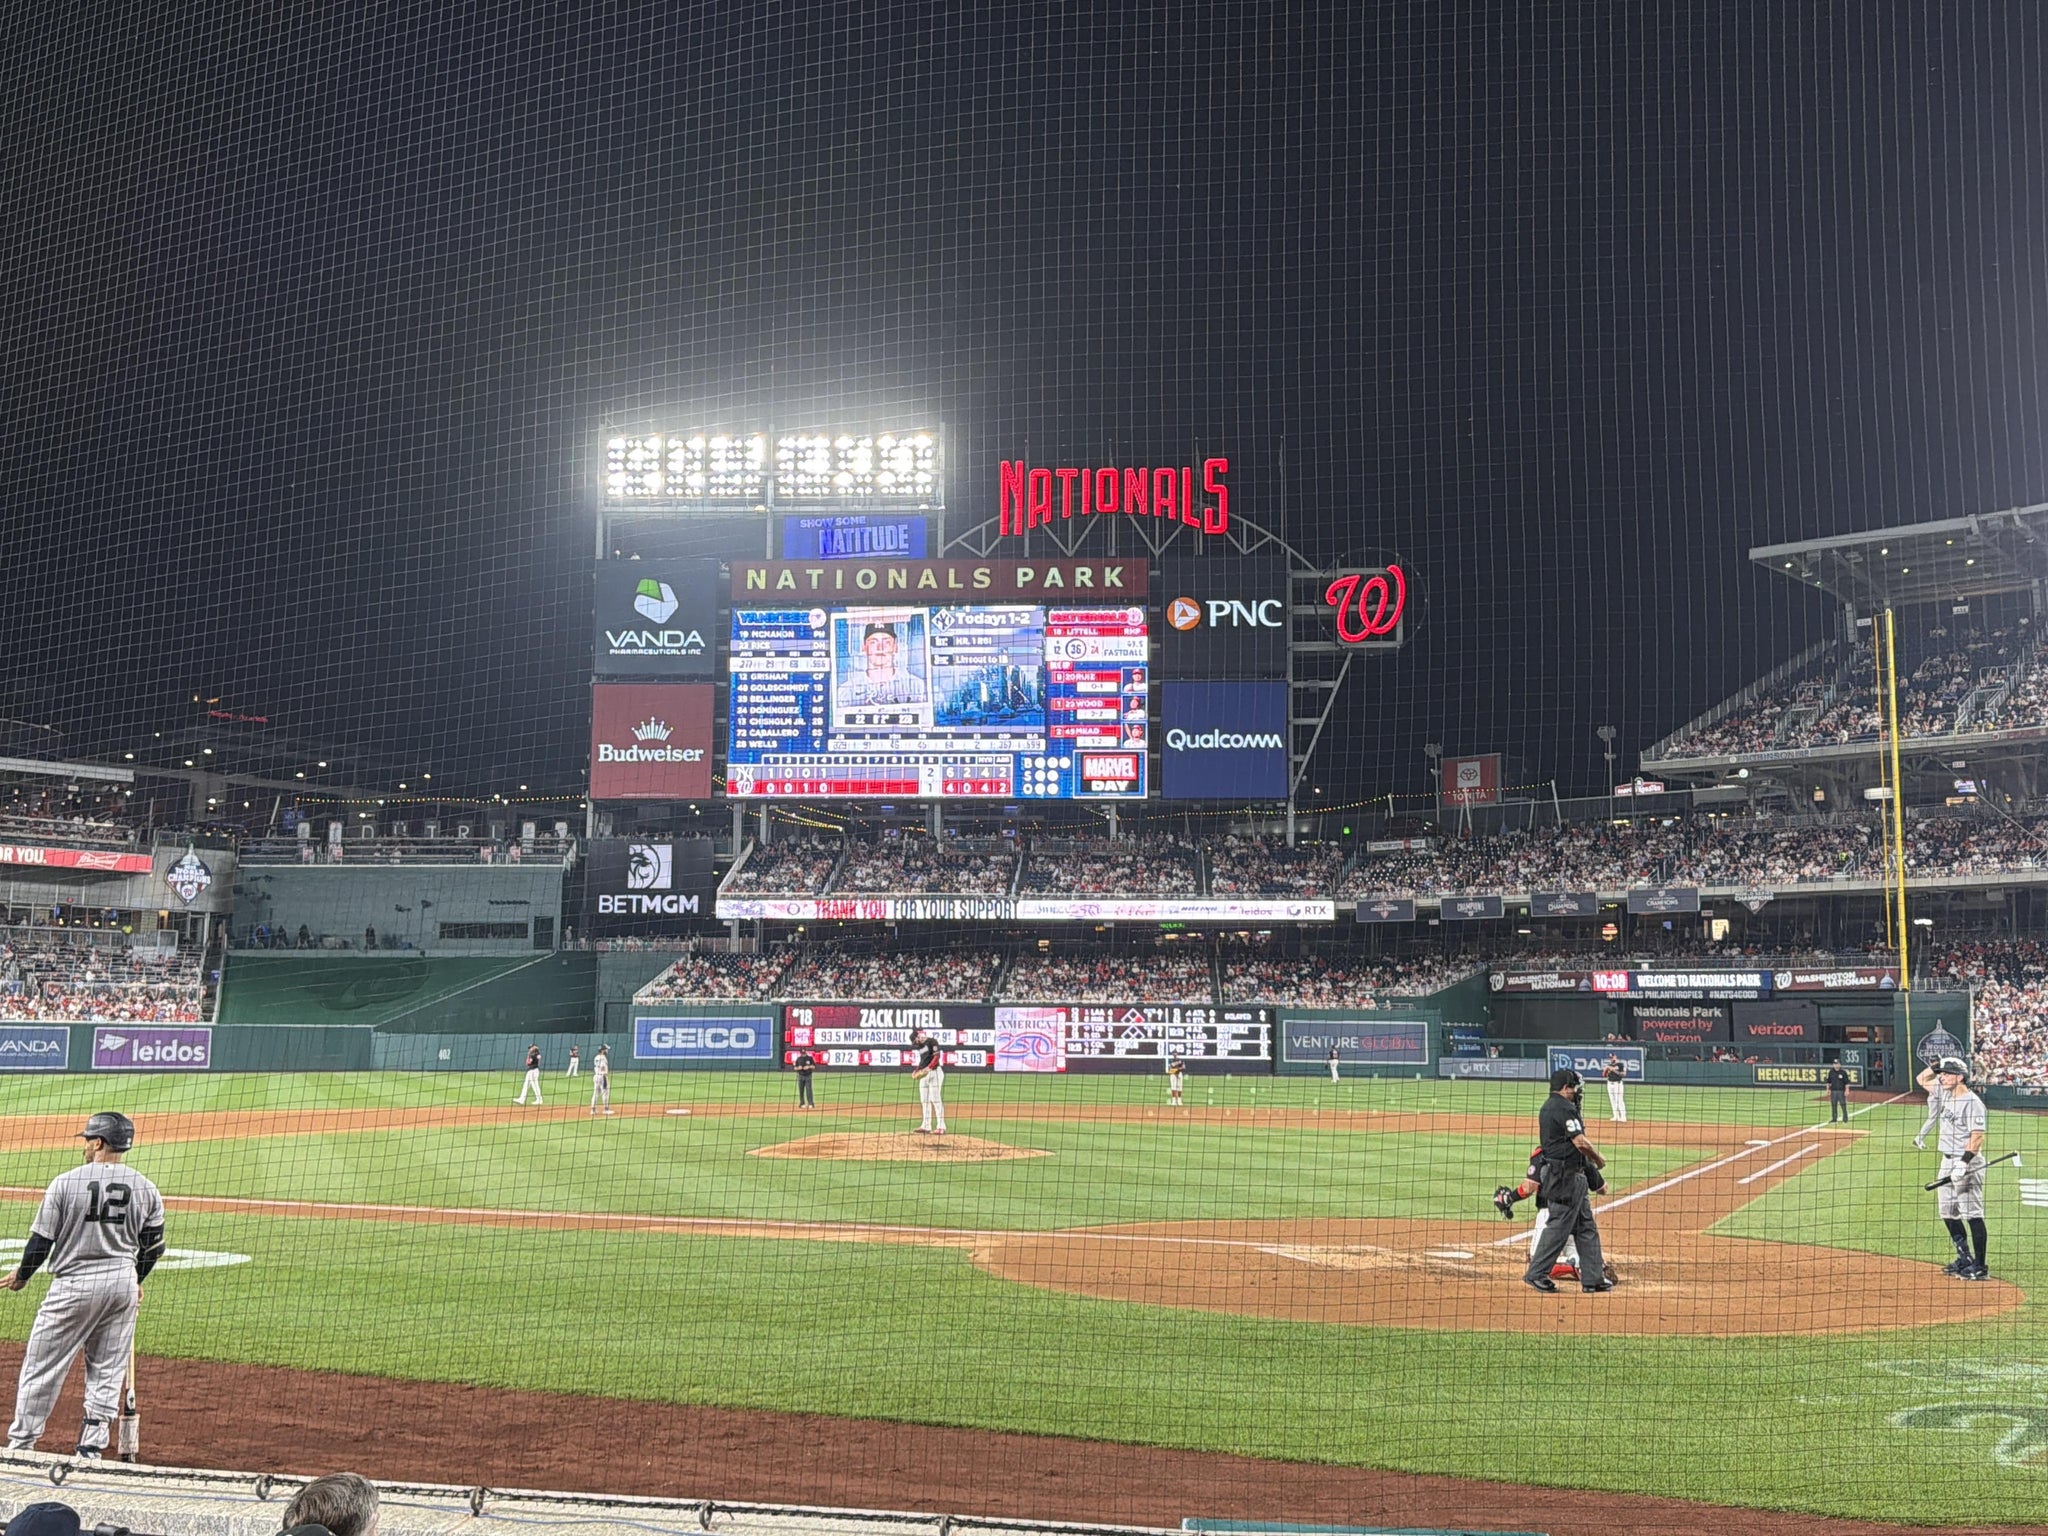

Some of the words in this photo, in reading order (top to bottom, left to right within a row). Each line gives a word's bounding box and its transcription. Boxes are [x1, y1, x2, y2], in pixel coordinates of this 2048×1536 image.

[1000, 458, 1228, 536] NATIONALS
[800, 518, 833, 528] SHOW
[836, 516, 867, 526] SOME
[819, 524, 909, 554] NATITUDE
[746, 567, 991, 591] NATIONALS
[1017, 566, 1124, 588] PARK
[956, 612, 1006, 626] Today:
[1009, 612, 1030, 624] 1-2
[1205, 600, 1283, 628] PNC
[1123, 627, 1141, 635] RHP
[605, 630, 705, 648] VANDA
[751, 641, 771, 650] RICE
[1053, 645, 1061, 655] 12
[1070, 644, 1082, 654] 36
[609, 648, 686, 656] PHARMACEUTICALS
[1103, 649, 1143, 657] FASTBALL
[751, 672, 788, 680] GRISHAM
[813, 672, 824, 680] CF
[1075, 673, 1096, 681] RUIZ
[750, 683, 809, 692] GOLDSCHMIDT
[750, 695, 795, 703] BELLINGER
[749, 717, 792, 726] CHISHOLM
[749, 729, 799, 737] CABALLERO
[1075, 727, 1100, 735] MEAD
[749, 740, 777, 748] WELLS
[813, 740, 821, 748] C
[1166, 728, 1283, 752] Qualcomm
[598, 744, 704, 762] Budweiser
[1023, 757, 1032, 768] B
[1085, 758, 1135, 777] MARVEL
[784, 767, 793, 778] 0
[802, 767, 811, 778] 0
[927, 768, 934, 778] 2
[946, 768, 954, 778] 6
[963, 768, 971, 778] 2
[980, 768, 990, 778] 4
[999, 768, 1007, 778] 2
[1023, 771, 1032, 781] S
[766, 782, 775, 793] 0
[784, 782, 793, 793] 0
[803, 782, 809, 793] 1
[819, 782, 828, 793] 0
[946, 783, 954, 793] 4
[963, 783, 971, 793] 0
[980, 783, 989, 793] 4
[999, 783, 1007, 793] 2
[1091, 780, 1129, 791] DAY
[16, 847, 47, 864] YOU.
[598, 895, 699, 914] BETMGM
[815, 900, 857, 919] THANK
[861, 900, 887, 919] YOU
[894, 900, 917, 919] FOR
[922, 900, 956, 919] YOUR
[959, 900, 1019, 919] SUPPORT
[1241, 906, 1273, 915] leidos
[1304, 906, 1326, 915] RTX
[1507, 973, 1558, 985] WASHINGTON
[1594, 974, 1626, 989] 10:08
[1637, 974, 1676, 987] WELCOME
[1677, 974, 1688, 987] TO
[1689, 974, 1736, 987] NATIONALS
[1736, 973, 1762, 987] PARK
[1795, 971, 1856, 983] WASHINGTON
[1825, 976, 1876, 988] NATIONALS
[1531, 979, 1576, 990] NATIONALS
[1607, 991, 1643, 999] NATIONALS
[1645, 990, 1703, 999] PHILANTHROPIES
[1709, 990, 1758, 998] #NATS4GOOD
[1633, 1006, 1690, 1017] Nationals
[1693, 1006, 1722, 1017] Park
[792, 1008, 812, 1026] #18
[860, 1008, 893, 1028] ZACK
[896, 1008, 943, 1028] LITTELL
[999, 1020, 1052, 1029] AMERICA
[1643, 1019, 1696, 1031] powered
[1698, 1018, 1713, 1031] by
[1748, 1022, 1803, 1036] verizon
[650, 1027, 756, 1049] GEICO
[821, 1031, 842, 1042] 93.5
[843, 1031, 864, 1042] MPH
[865, 1031, 906, 1042] FASTBALL
[1656, 1032, 1702, 1042] Verizon
[1292, 1036, 1359, 1049] VENTURE
[1361, 1037, 1420, 1050] GLOBAL
[132, 1039, 206, 1062] leidos
[438, 1048, 450, 1061] 402
[961, 1053, 982, 1064] 5.03
[1845, 1050, 1860, 1063] 335
[1472, 1063, 1491, 1072] RTX
[1757, 1068, 1817, 1082] HERCULES
[85, 1180, 132, 1225] 12
